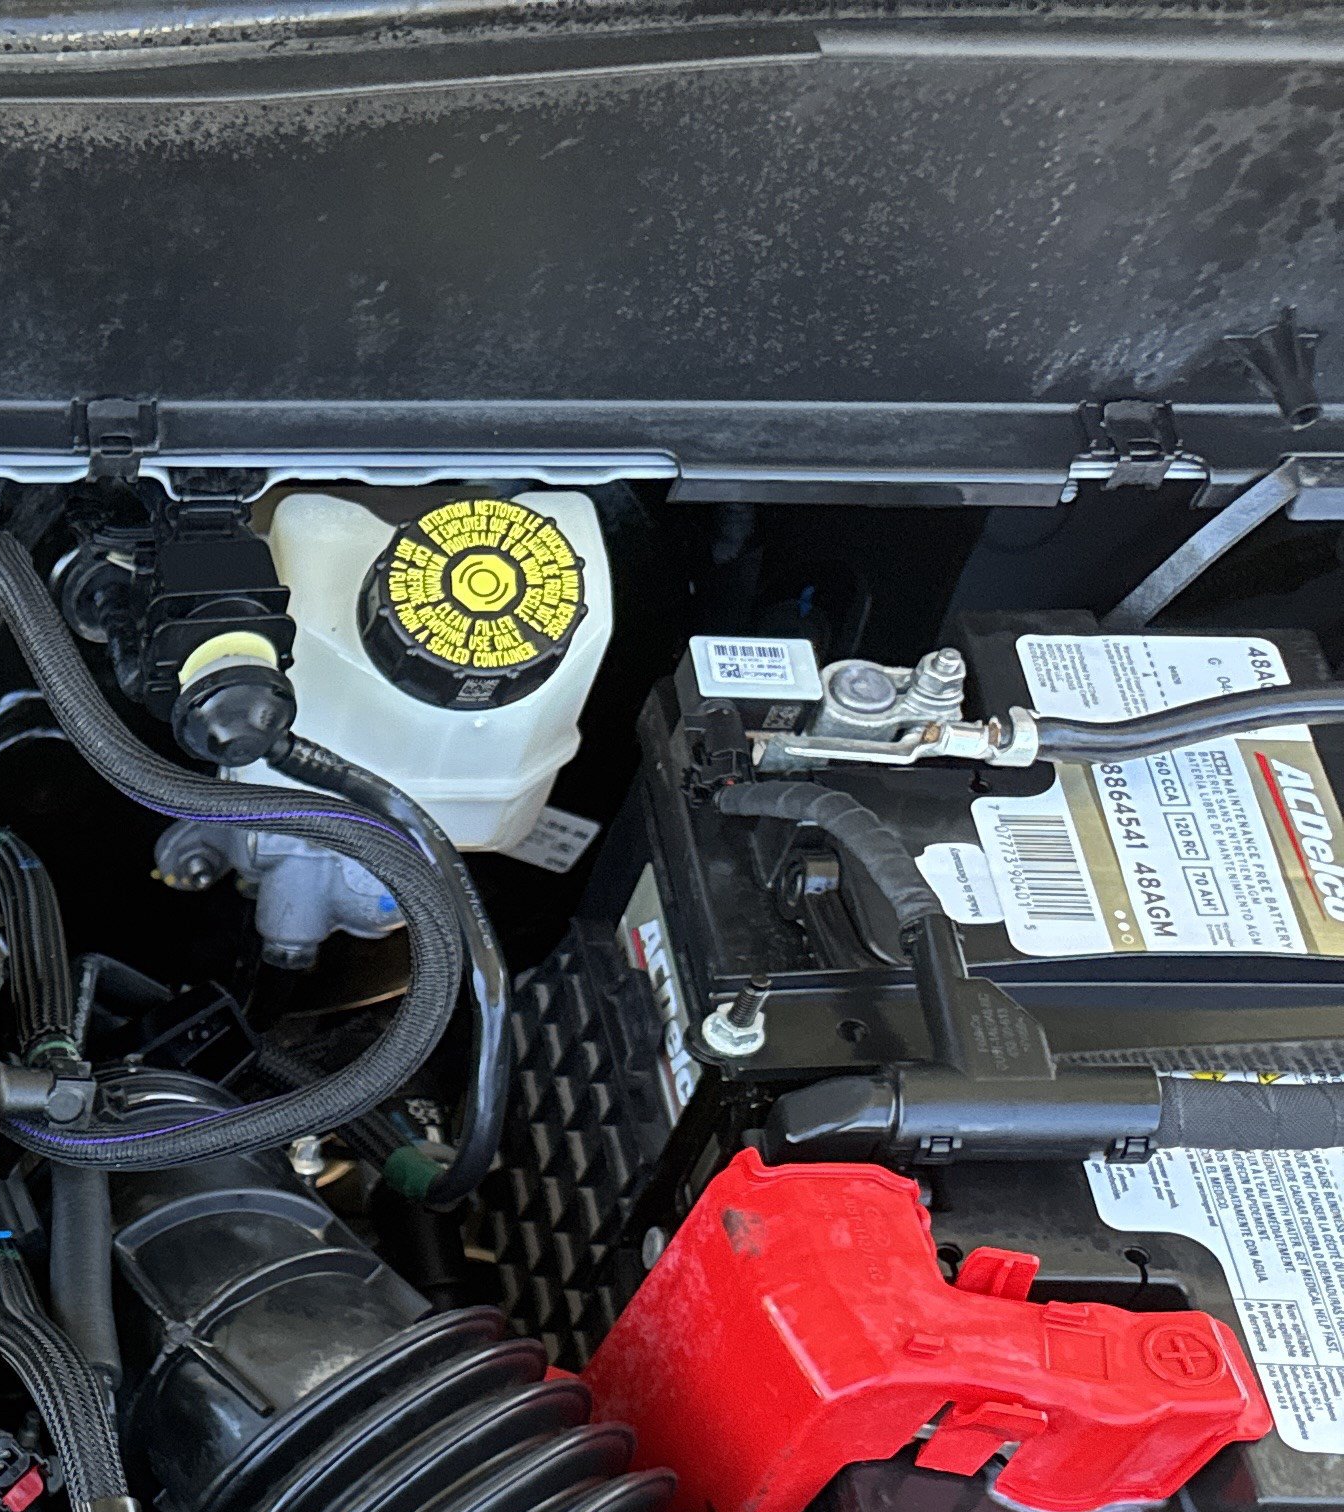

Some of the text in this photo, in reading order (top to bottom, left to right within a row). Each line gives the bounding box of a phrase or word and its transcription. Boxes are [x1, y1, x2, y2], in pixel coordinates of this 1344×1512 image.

[394, 537, 418, 562] DOT
[418, 500, 471, 534] ATTENTION
[474, 499, 528, 523] NETTOYER
[525, 514, 543, 531] LE
[537, 524, 576, 568] BOUCHON
[560, 569, 579, 602] AVANT
[440, 531, 503, 557] PROVENANT
[388, 570, 408, 602] FLUID
[406, 545, 525, 651] CAP BEFORE REMOVING USE ONLY
[424, 553, 517, 636] WARNING CLEAN FILLER
[394, 601, 423, 634] FROM
[414, 630, 429, 644] A
[425, 636, 470, 665] SEALED
[472, 641, 539, 668] CONTAINER
[1150, 754, 1182, 802] 760 CCA
[1197, 792, 1219, 820] LIBRE
[992, 825, 1020, 863] 07773
[1172, 816, 1200, 856] 120 RC
[1196, 751, 1263, 905] BATTERIE SANS ENTRETIEN AGM
[1208, 822, 1225, 836] DE
[1269, 758, 1344, 922] ACDelco
[1190, 871, 1210, 886] 70
[1213, 839, 1255, 921] MANTENIMIENTO
[1220, 778, 1262, 860] MAINTENANCE
[1250, 863, 1274, 893] FREE
[1262, 896, 1294, 949] BATTERY
[1005, 869, 1033, 907] 90401
[1128, 861, 1180, 938] 48AGM
[1244, 924, 1264, 945] AGM
[1273, 1194, 1291, 1216] WITH
[1313, 1165, 1344, 1233] CAUSE BLINDNESS
[1242, 1238, 1260, 1256] CON
[1292, 1250, 1309, 1267] GET
[1298, 1268, 1323, 1306] MEDICAL
[1312, 1307, 1332, 1329] HELP
